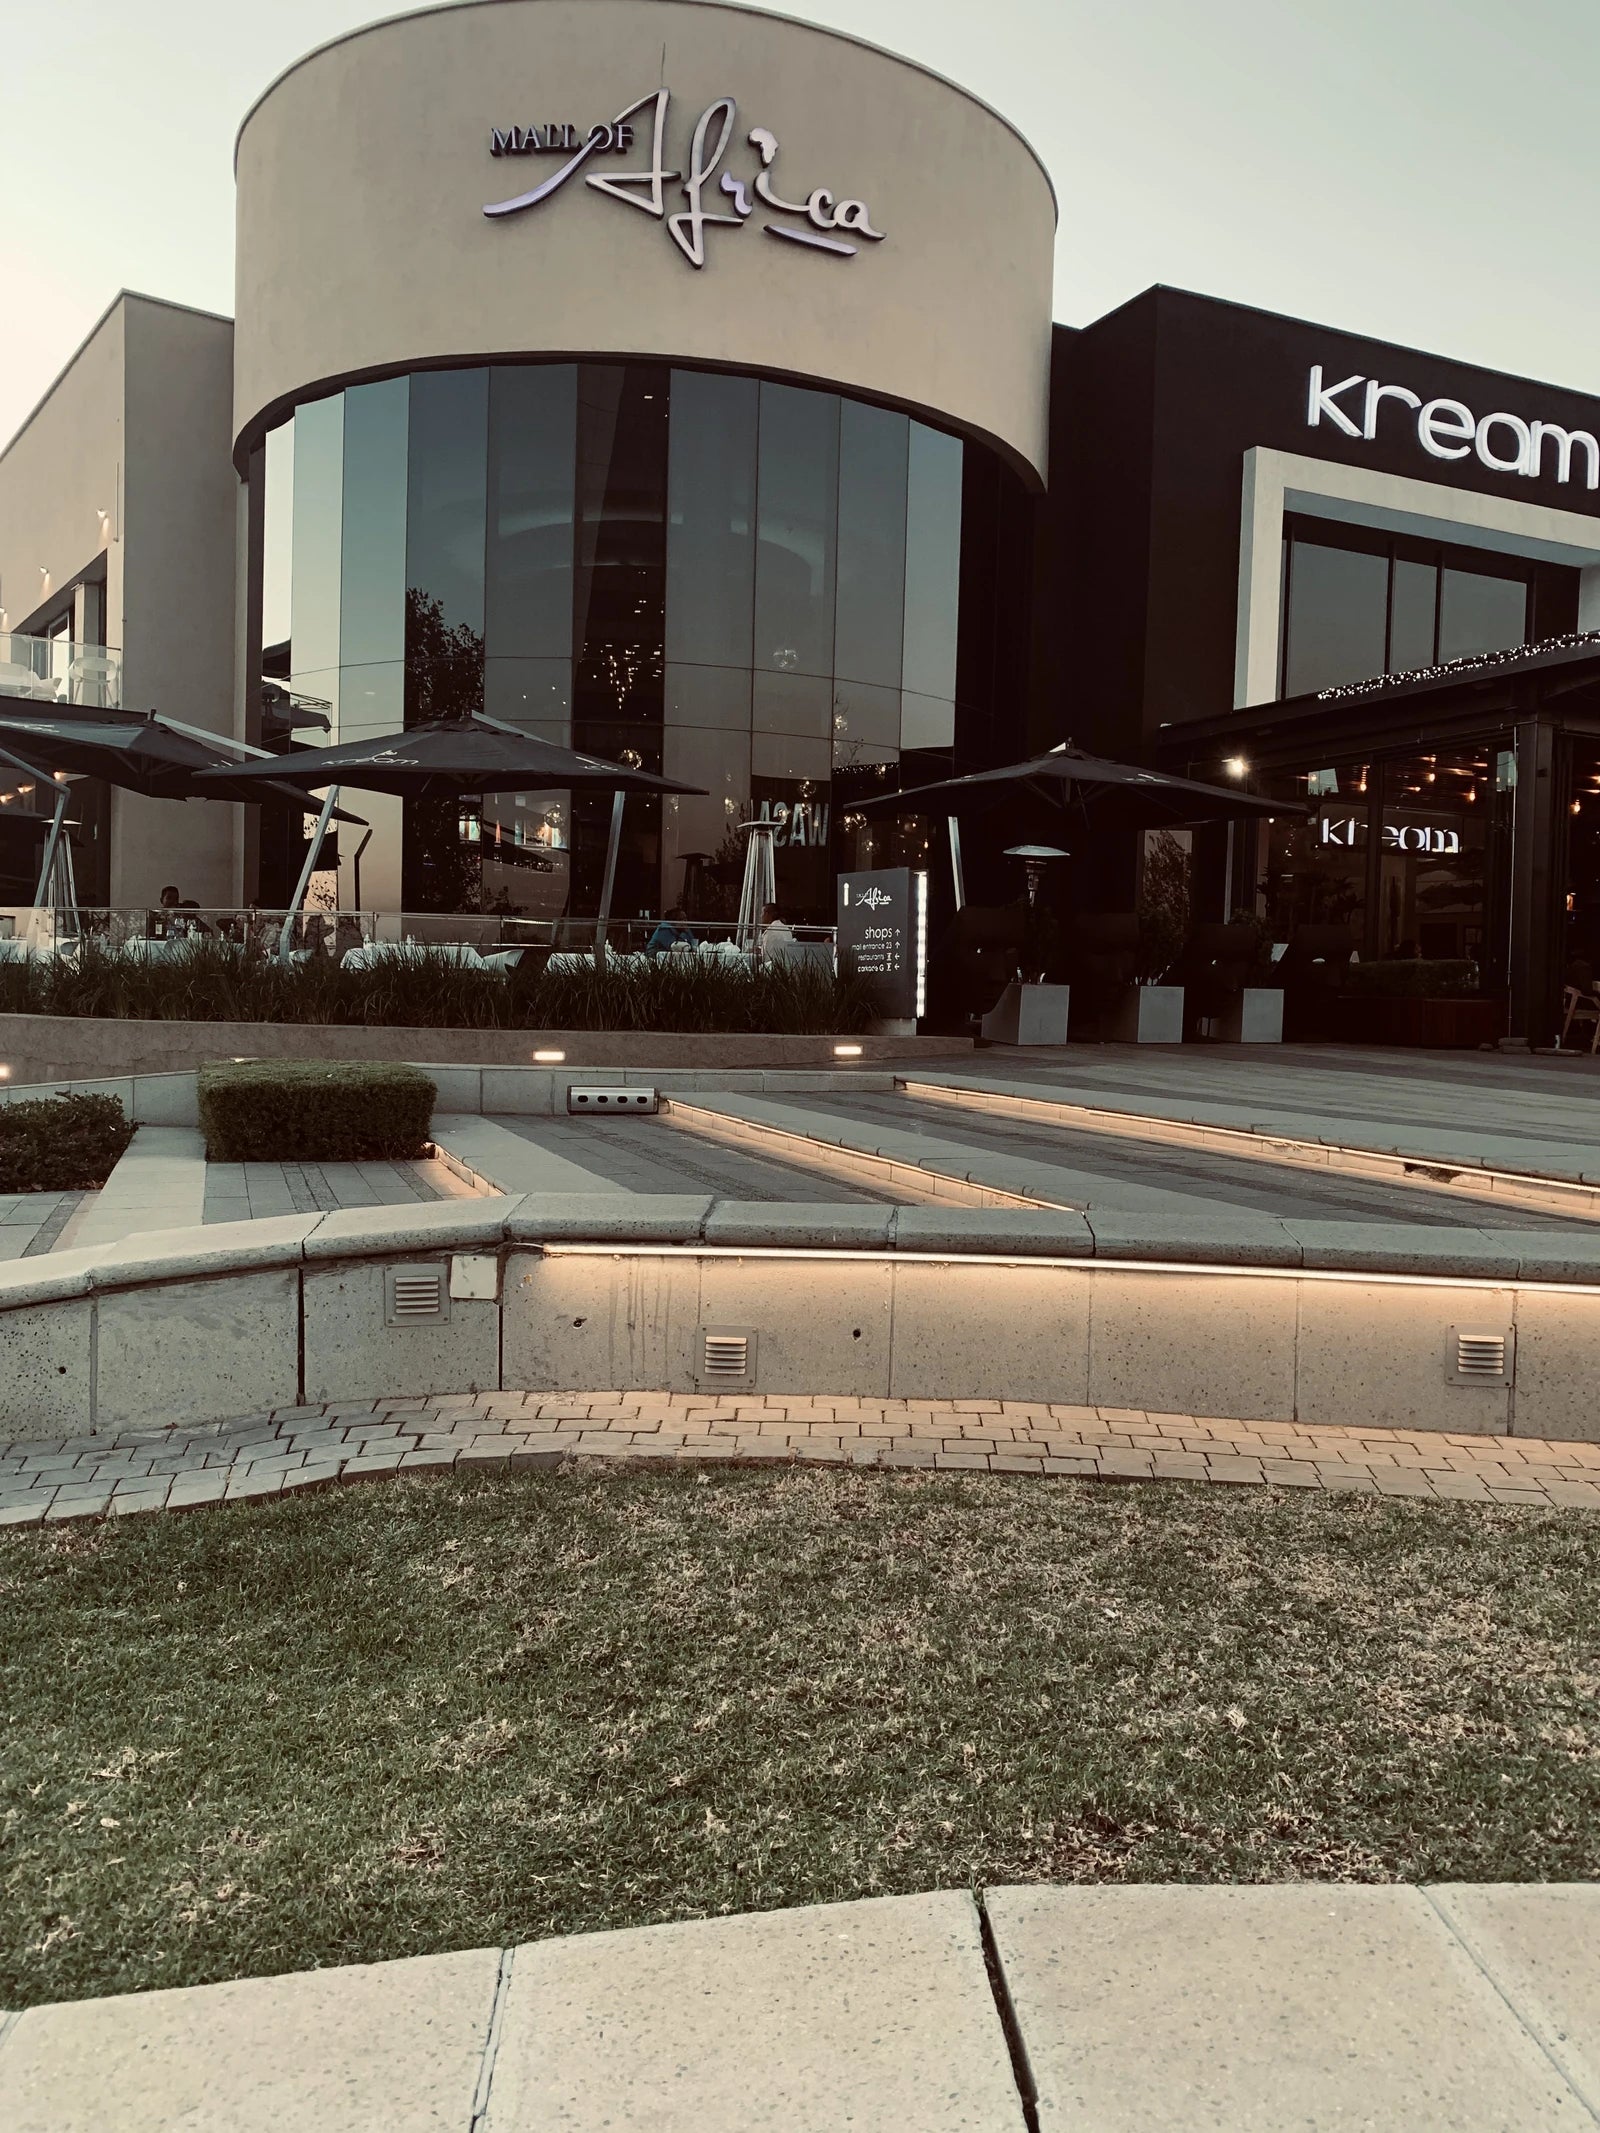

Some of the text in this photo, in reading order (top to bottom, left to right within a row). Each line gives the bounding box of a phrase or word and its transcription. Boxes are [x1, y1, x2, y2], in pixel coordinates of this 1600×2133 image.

[482, 87, 887, 269] MALL OF Africa
[1307, 364, 1599, 490] kream
[864, 926, 893, 940] shops
